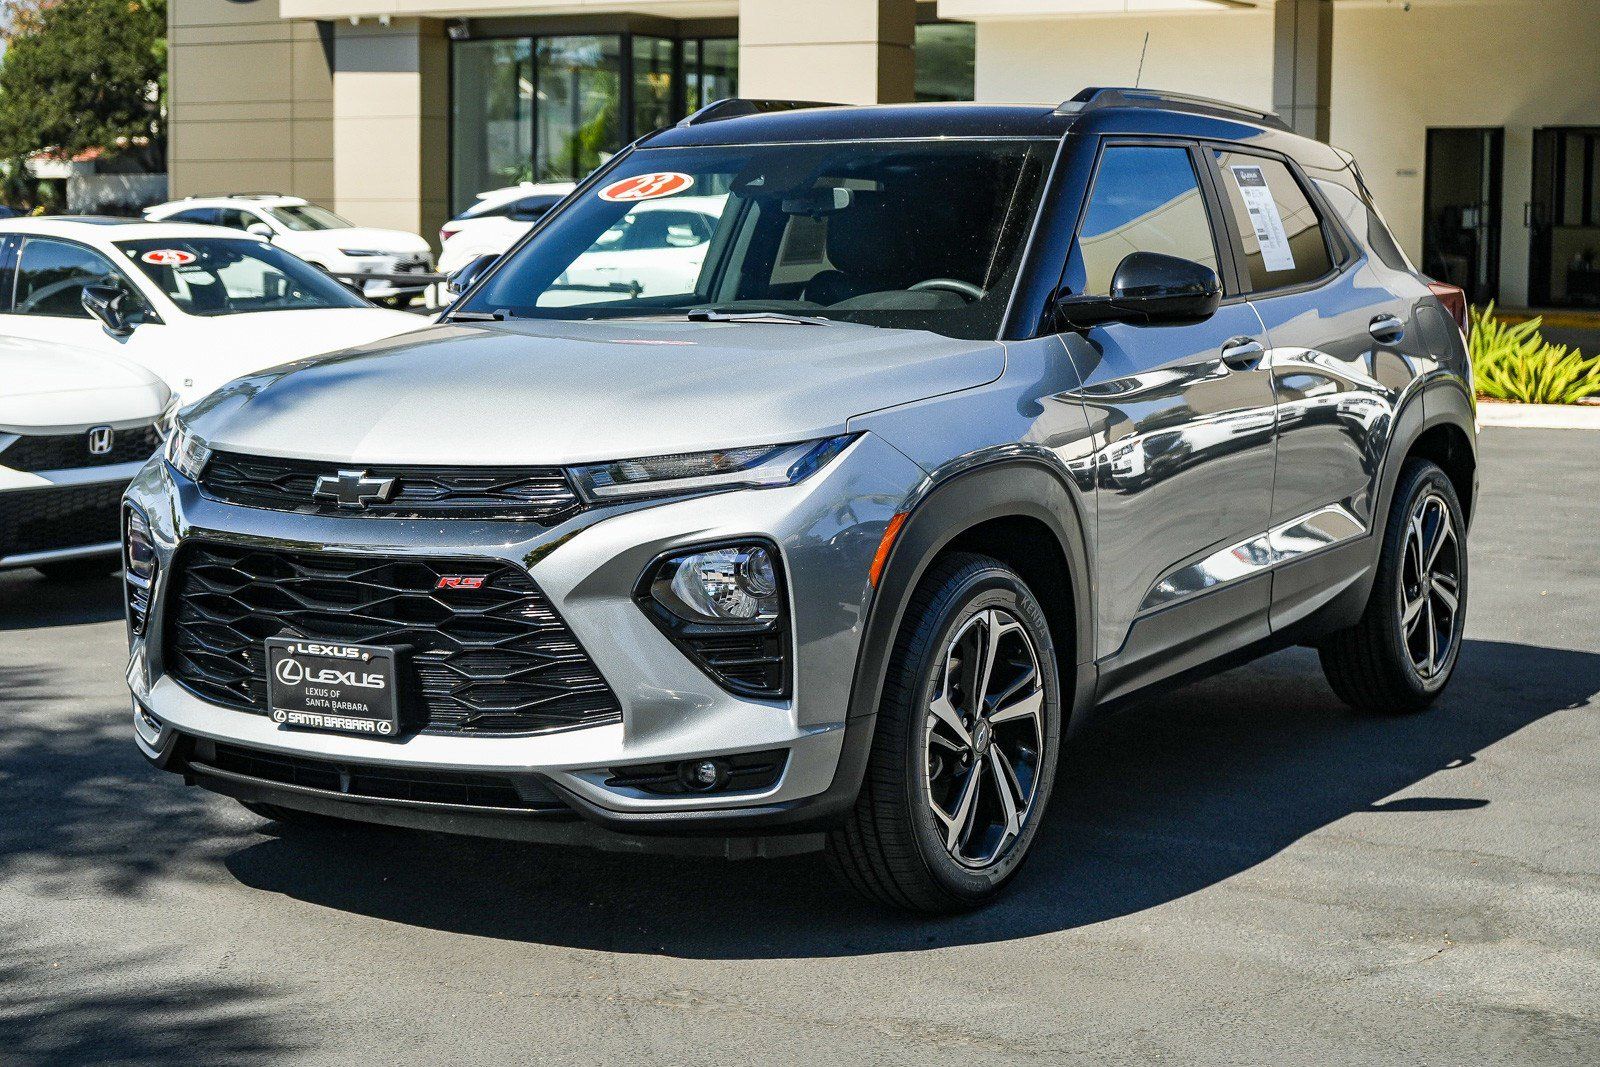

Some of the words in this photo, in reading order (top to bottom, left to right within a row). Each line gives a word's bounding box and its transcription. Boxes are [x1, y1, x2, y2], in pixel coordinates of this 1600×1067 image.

[614, 174, 676, 199] 23
[437, 577, 485, 589] RS
[1020, 596, 1047, 639] KENDA
[298, 644, 359, 658] LEXUS
[305, 667, 385, 689] LEXUS
[305, 687, 328, 697] LEXUS
[330, 690, 341, 698] OF
[305, 698, 330, 708] SANTA
[332, 701, 368, 711] BARBARA
[288, 713, 323, 727] SANTA
[324, 716, 375, 731] BARBARA
